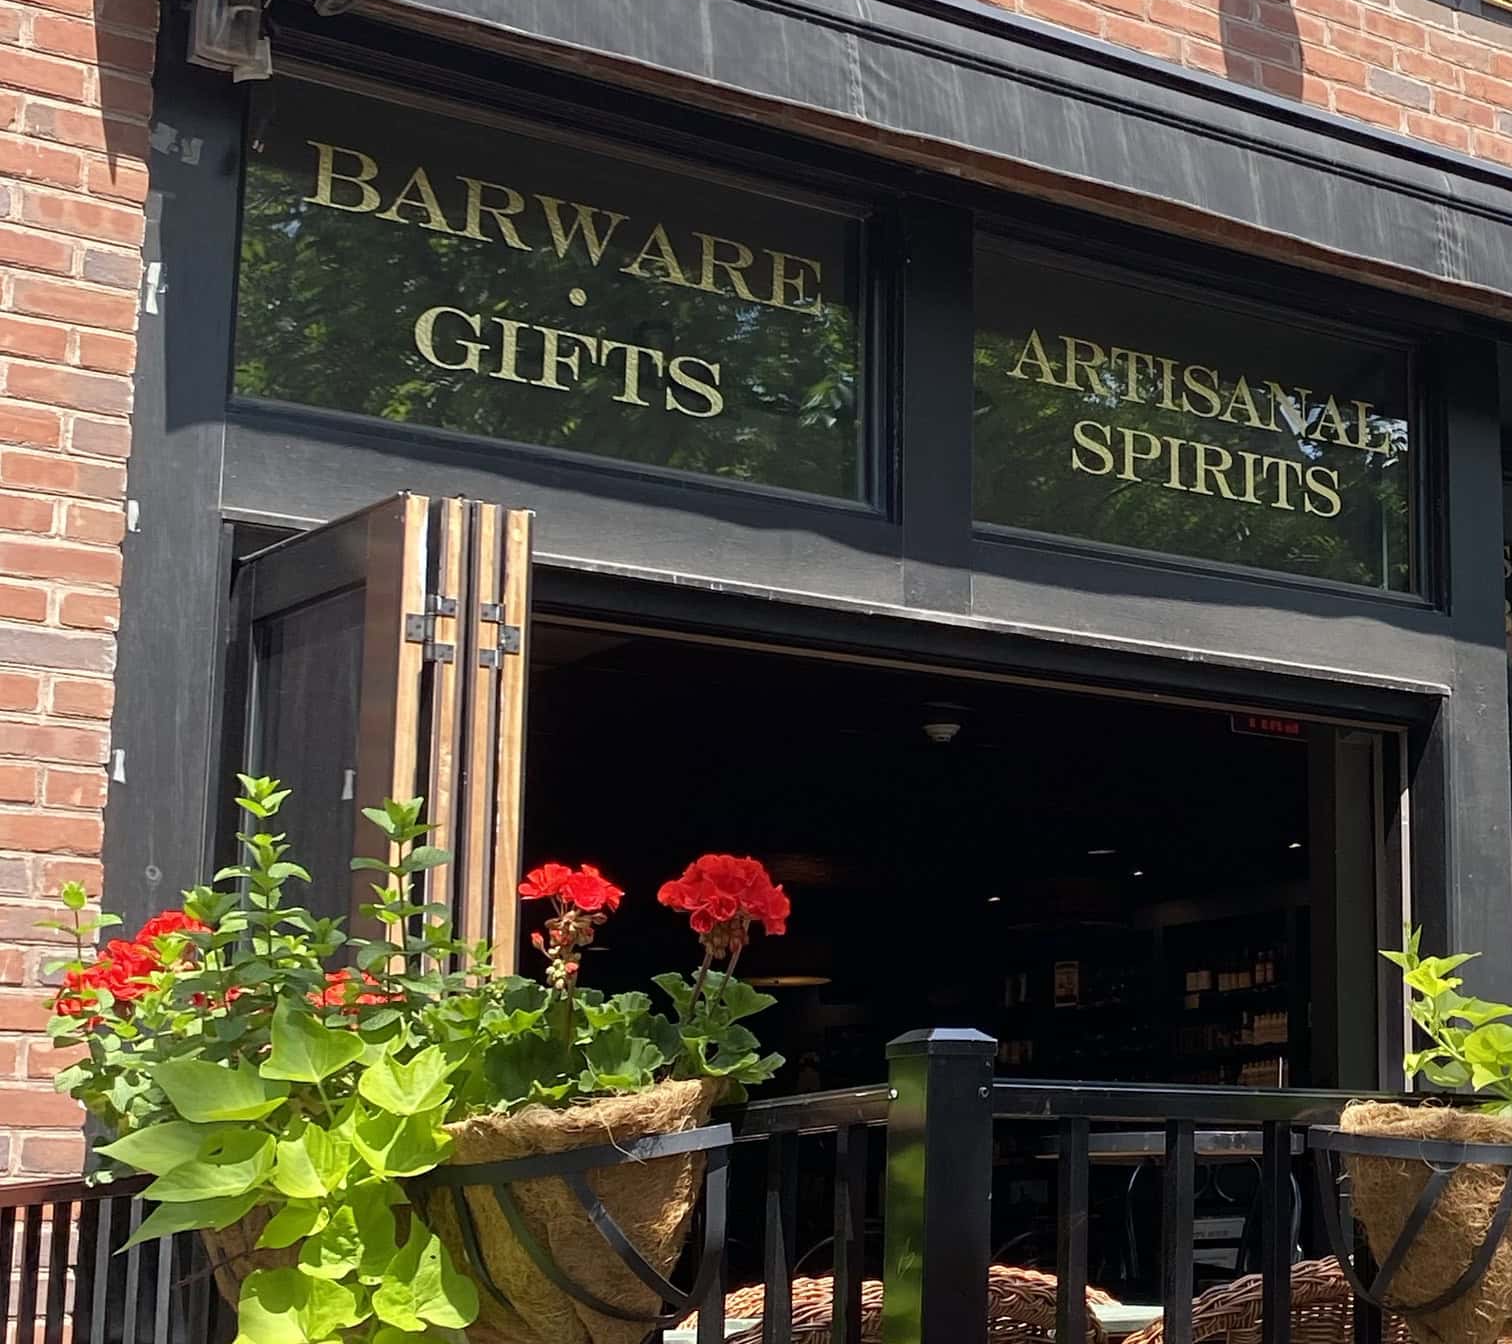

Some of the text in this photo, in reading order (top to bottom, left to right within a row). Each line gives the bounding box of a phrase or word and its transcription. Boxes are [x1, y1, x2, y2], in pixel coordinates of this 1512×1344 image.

[304, 140, 823, 316] BARWARE
[414, 305, 725, 418] GIFTS
[1006, 328, 1391, 454] ARTISANAL
[1071, 420, 1342, 518] SPIRITS
